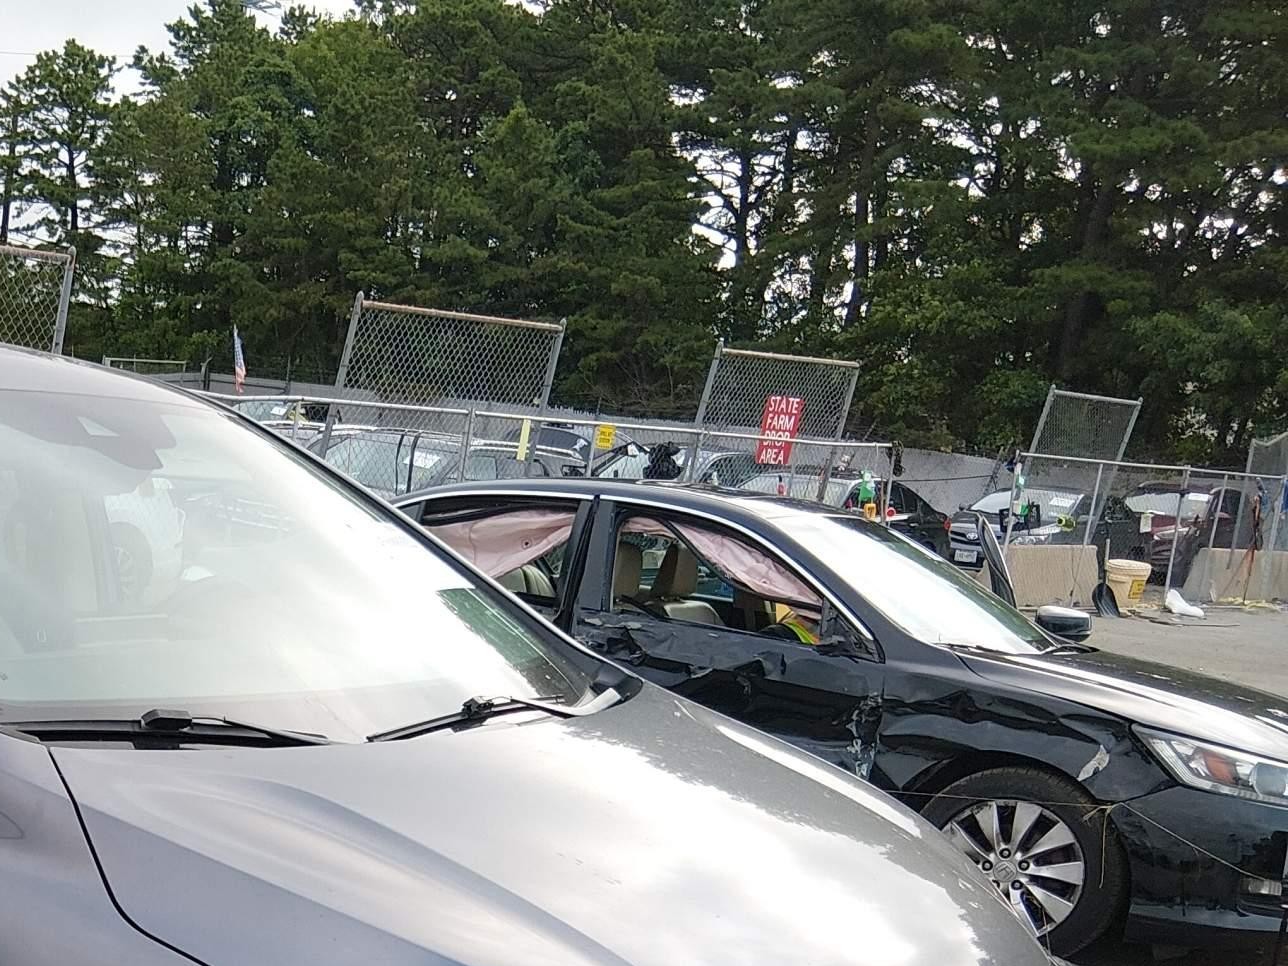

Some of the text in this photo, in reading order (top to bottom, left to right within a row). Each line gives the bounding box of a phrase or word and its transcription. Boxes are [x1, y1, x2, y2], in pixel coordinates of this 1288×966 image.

[769, 396, 800, 413] STATE
[766, 414, 795, 431] FARM
[763, 430, 791, 447] DROP
[759, 448, 784, 465] AREA
